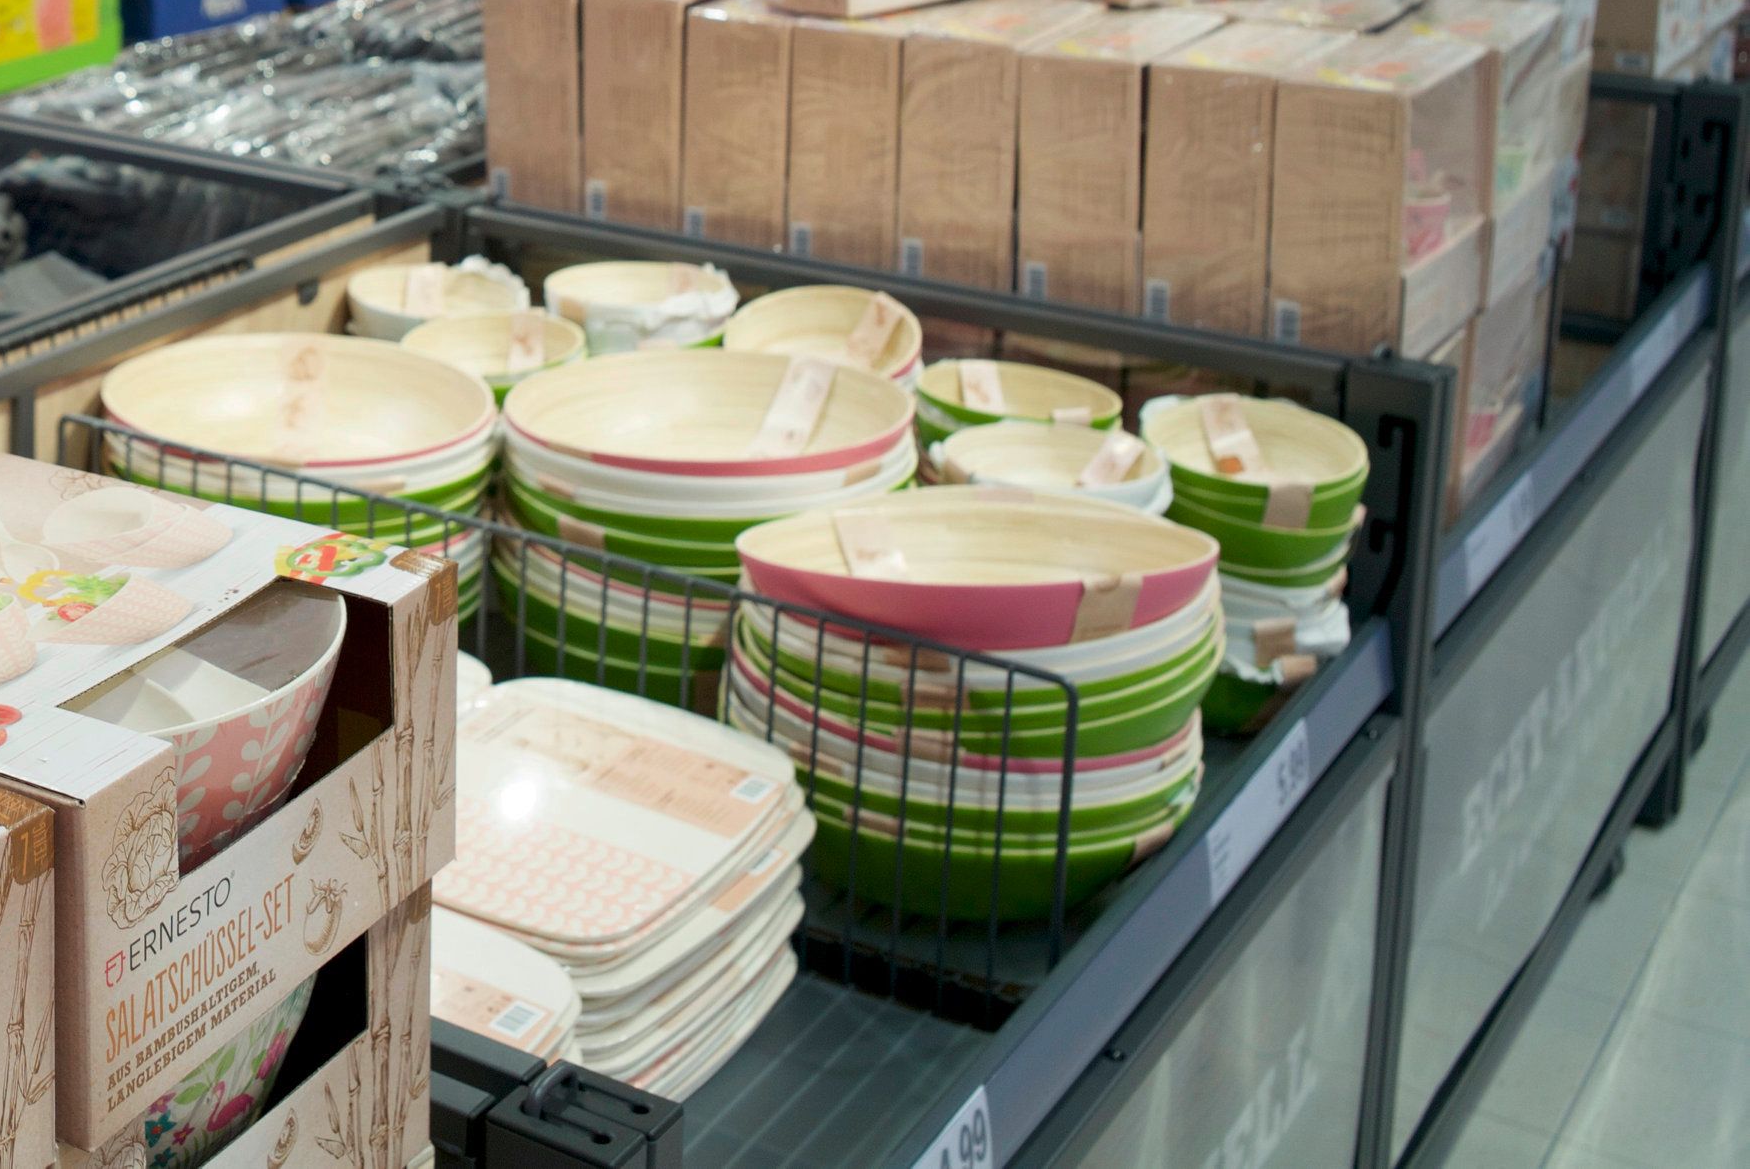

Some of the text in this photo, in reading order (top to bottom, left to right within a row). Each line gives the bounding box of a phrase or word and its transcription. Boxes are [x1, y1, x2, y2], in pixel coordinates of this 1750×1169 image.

[105, 872, 296, 1064] SALATSCHÜSSEL-SET
[128, 877, 233, 973] ERNESTO
[107, 961, 261, 1093] AUS BAMBUSHALTIGEM,
[107, 968, 278, 1114] LANGLEBIGEM MATERIAL
